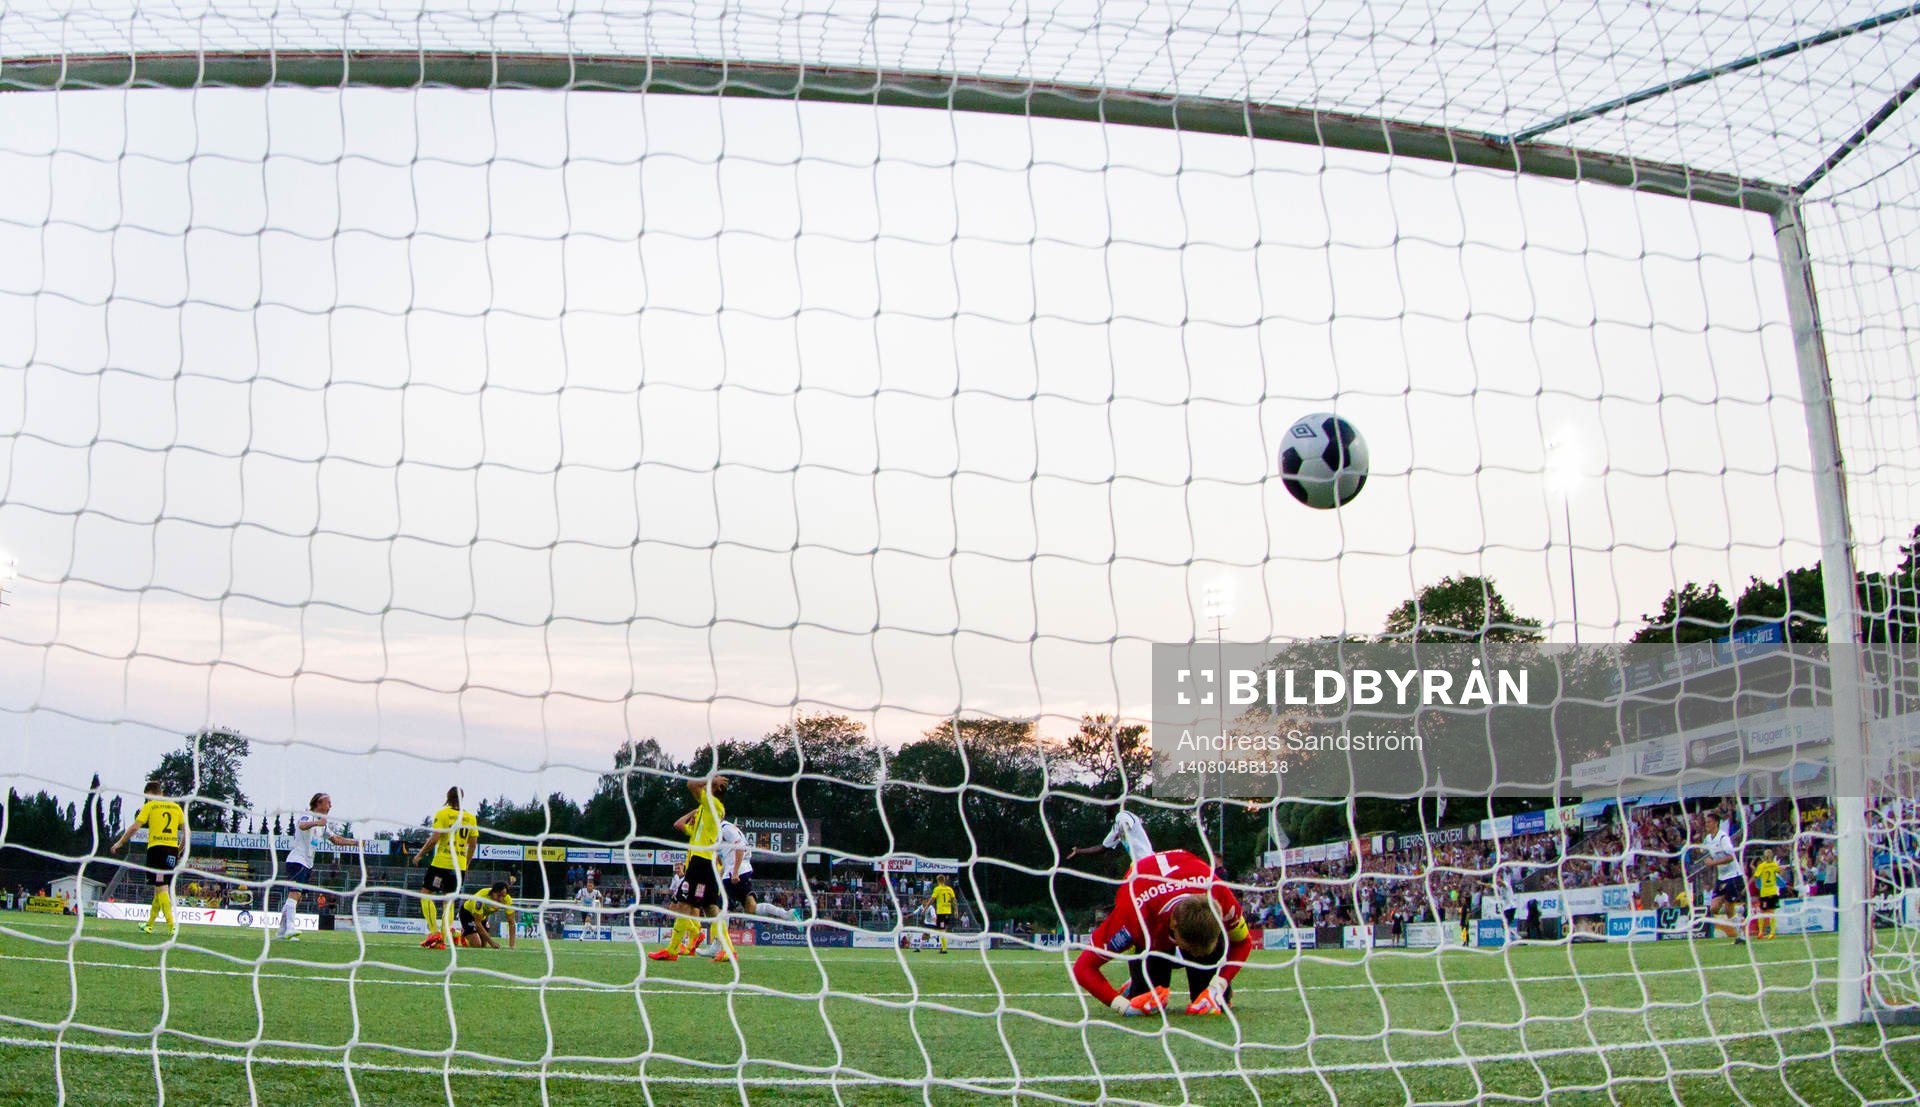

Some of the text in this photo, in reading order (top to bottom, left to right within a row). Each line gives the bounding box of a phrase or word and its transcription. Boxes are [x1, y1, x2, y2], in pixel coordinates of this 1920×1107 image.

[162, 811, 172, 833] 2
[745, 819, 800, 829] Klockmaster
[223, 835, 290, 850] Arbetarbldet
[492, 848, 521, 857] Grontmij
[125, 907, 200, 921] KUMO YRES
